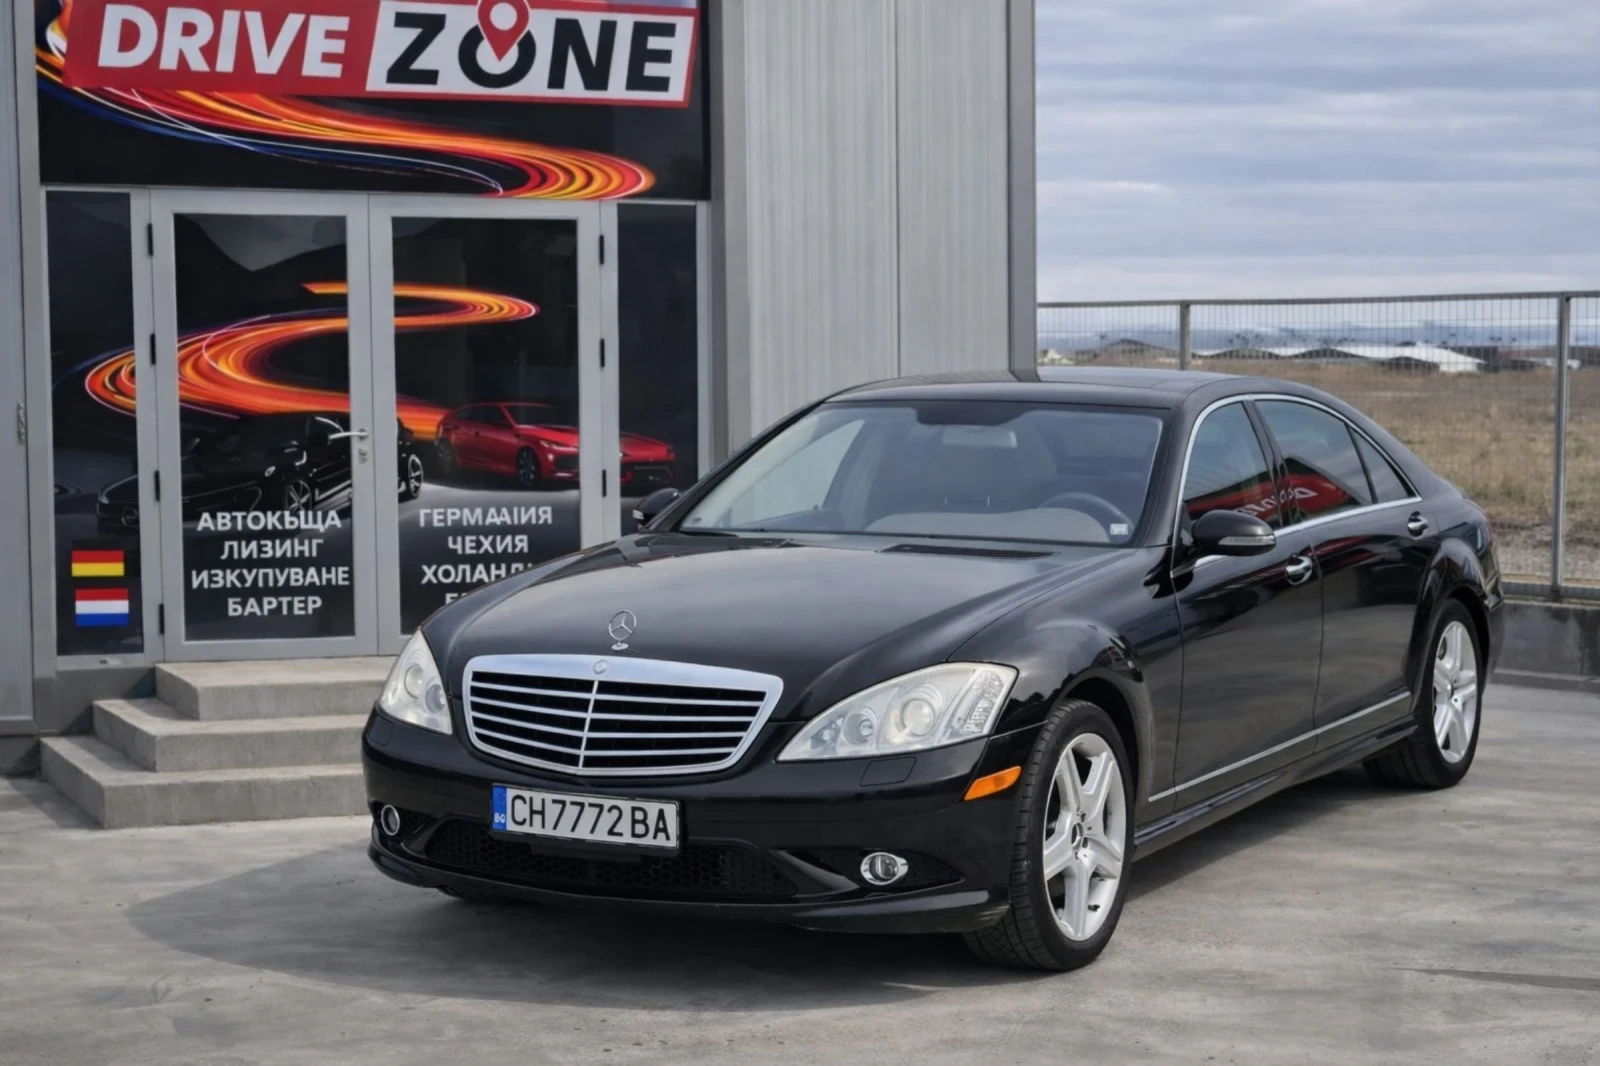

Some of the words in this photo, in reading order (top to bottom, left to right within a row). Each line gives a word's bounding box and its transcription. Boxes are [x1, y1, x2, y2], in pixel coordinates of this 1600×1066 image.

[97, 4, 350, 79] DRIVE
[385, 11, 677, 94] ZONE
[220, 538, 324, 560] ЛИЗИНГ
[448, 534, 529, 555] ЧЕХИЯ
[191, 566, 350, 590] ИЗКУПУВАНЕ
[227, 596, 323, 617] БАРТЕР
